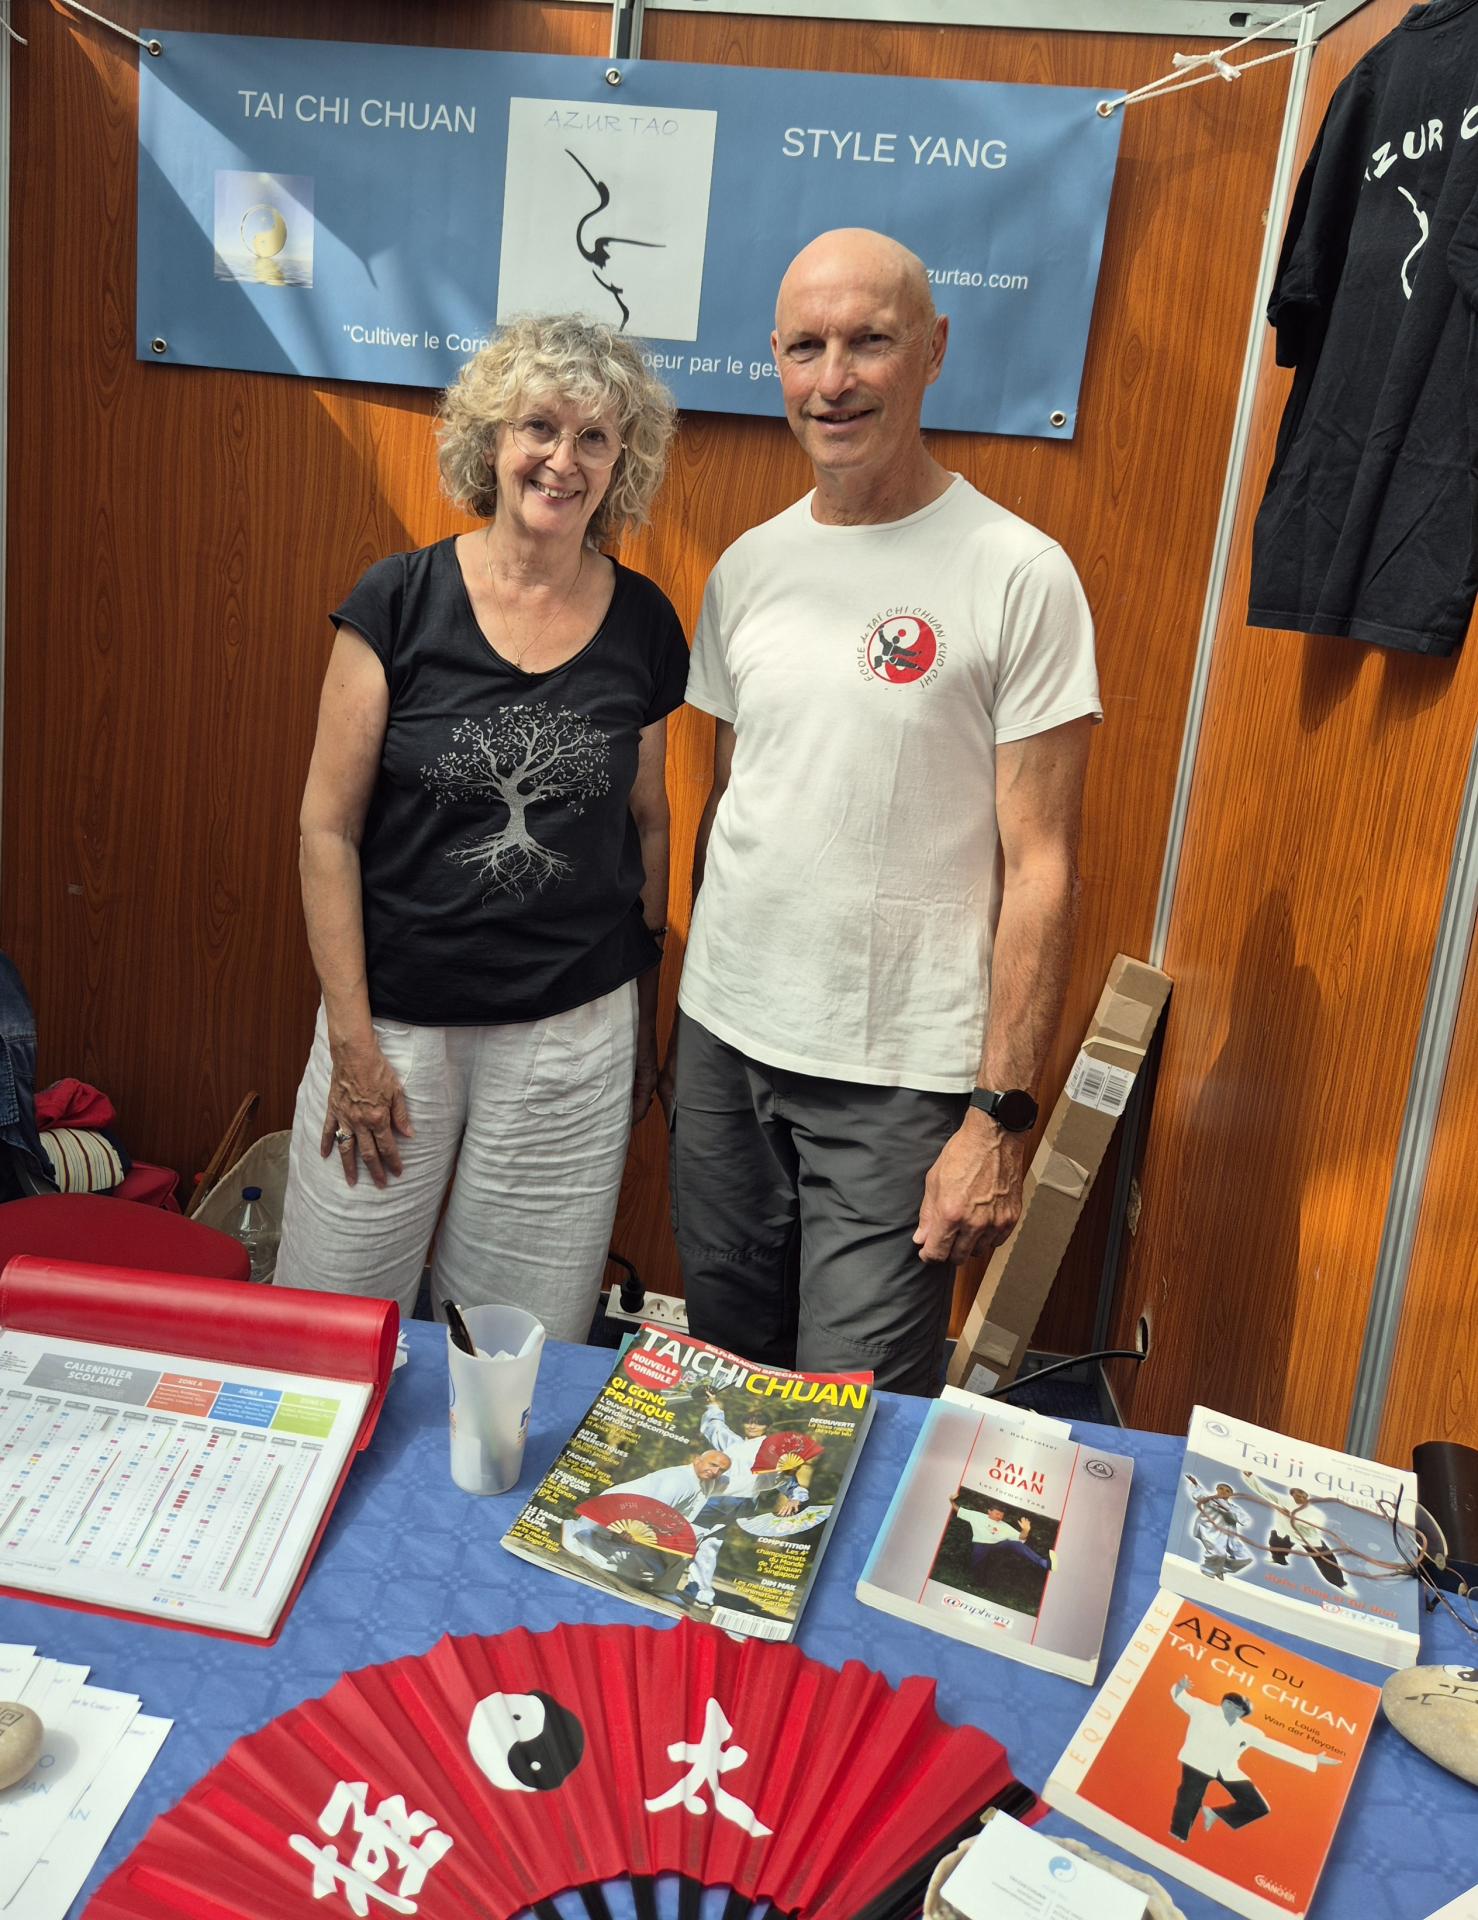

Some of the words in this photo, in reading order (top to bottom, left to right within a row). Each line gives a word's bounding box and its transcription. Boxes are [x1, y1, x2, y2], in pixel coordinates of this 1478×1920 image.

[238, 90, 284, 119] TAI
[295, 95, 349, 125] CHI
[361, 100, 476, 134] CHUAN
[782, 126, 896, 163] STYLE
[908, 135, 1008, 169] YANG
[1364, 118, 1443, 181] ZUR
[926, 268, 1028, 290] zurtao.com
[343, 324, 418, 347] "Cultiver
[424, 331, 439, 349] le
[446, 333, 491, 353] Corp
[641, 353, 684, 370] oeur
[690, 356, 721, 375] par
[726, 356, 743, 374] le
[749, 360, 780, 380] ges
[866, 613, 883, 631] TAI
[886, 606, 909, 617] CHI
[912, 607, 945, 638] CHUAN
[920, 669, 938, 688] CHI
[64, 1361, 133, 1380] CALENDRIER
[628, 1359, 672, 1385] FORMULE
[631, 1352, 678, 1377] NOUVELLE
[68, 1371, 122, 1387] SCOLAIRE
[610, 1375, 627, 1392] QI
[627, 1383, 667, 1407] GONG
[603, 1385, 675, 1423] PRATIQUE
[591, 1409, 602, 1418] en
[603, 1413, 632, 1431] photos
[646, 1415, 662, 1426] des
[664, 1421, 676, 1431] 12
[579, 1427, 598, 1440] ARTS
[994, 1457, 1023, 1476] TAI
[1235, 1439, 1278, 1469] Tai
[1288, 1458, 1305, 1478] ji
[988, 1467, 1044, 1495] QUAN
[528, 1504, 537, 1512] LE
[758, 1537, 811, 1551] COMPETITION
[1174, 1616, 1266, 1669] ABC
[1271, 1667, 1304, 1688] DU
[1210, 1656, 1253, 1688] CHI
[1262, 1682, 1357, 1735] CHUAN
[1263, 1713, 1288, 1731] Wan
[1287, 1723, 1304, 1738] der
[1294, 1719, 1320, 1737] Louis
[644, 1697, 774, 1838] 太
